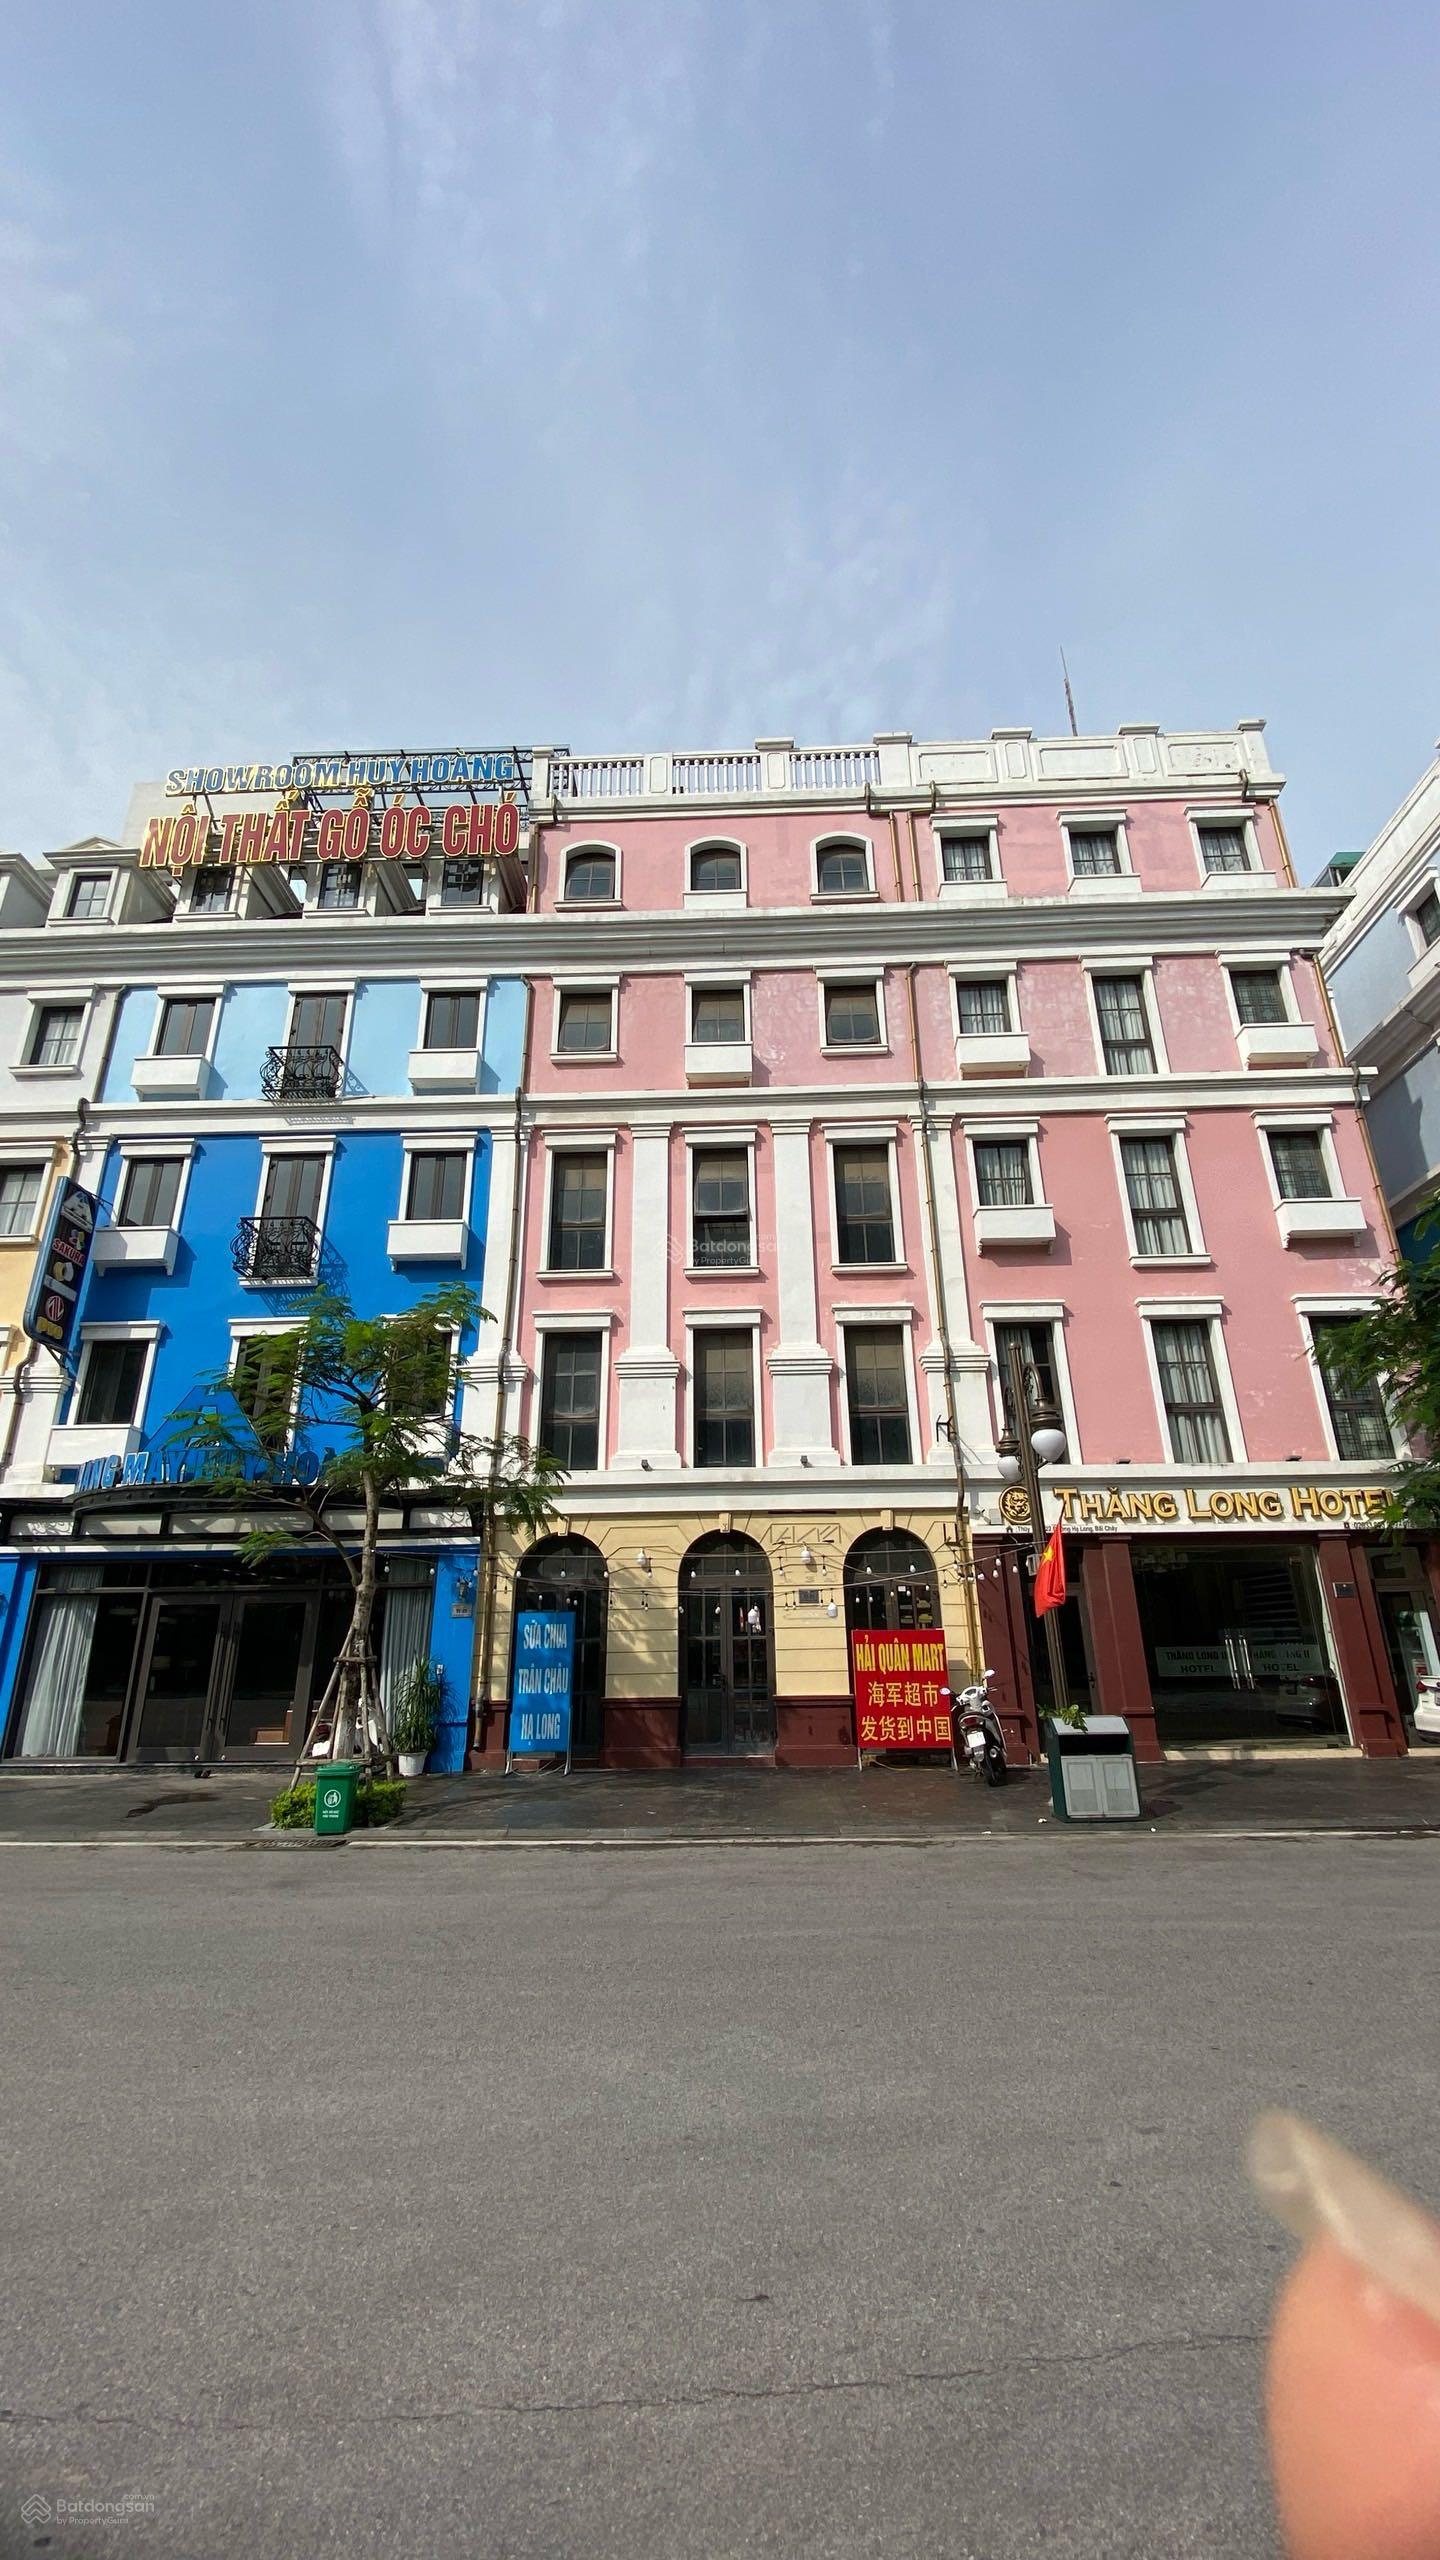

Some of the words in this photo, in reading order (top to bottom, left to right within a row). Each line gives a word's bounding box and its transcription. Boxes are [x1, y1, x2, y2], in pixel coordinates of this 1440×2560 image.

[166, 763, 341, 794] SHOWROOM
[346, 759, 406, 785] HUY
[410, 747, 514, 783] HOÀNG
[139, 803, 210, 877] NỘI
[219, 789, 312, 863] THẤT
[317, 787, 370, 860] GỖ
[380, 793, 431, 858] ÓC
[442, 791, 519, 856] CHÓ
[52, 1238, 86, 1267] SAKURA
[1053, 1486, 1178, 1519] THĂNG
[1184, 1487, 1283, 1519] LONG
[856, 1634, 876, 1671] HẢI
[878, 1637, 910, 1674] QUÂN
[912, 1644, 944, 1671] MART
[1181, 1664, 1216, 1673] HOTEL
[519, 1663, 541, 1694] TRÂN
[868, 1681, 939, 1707] 海军超市
[520, 1714, 534, 1746] HẠ
[536, 1713, 560, 1740] LONG
[861, 1715, 952, 1742] 发货到中国
